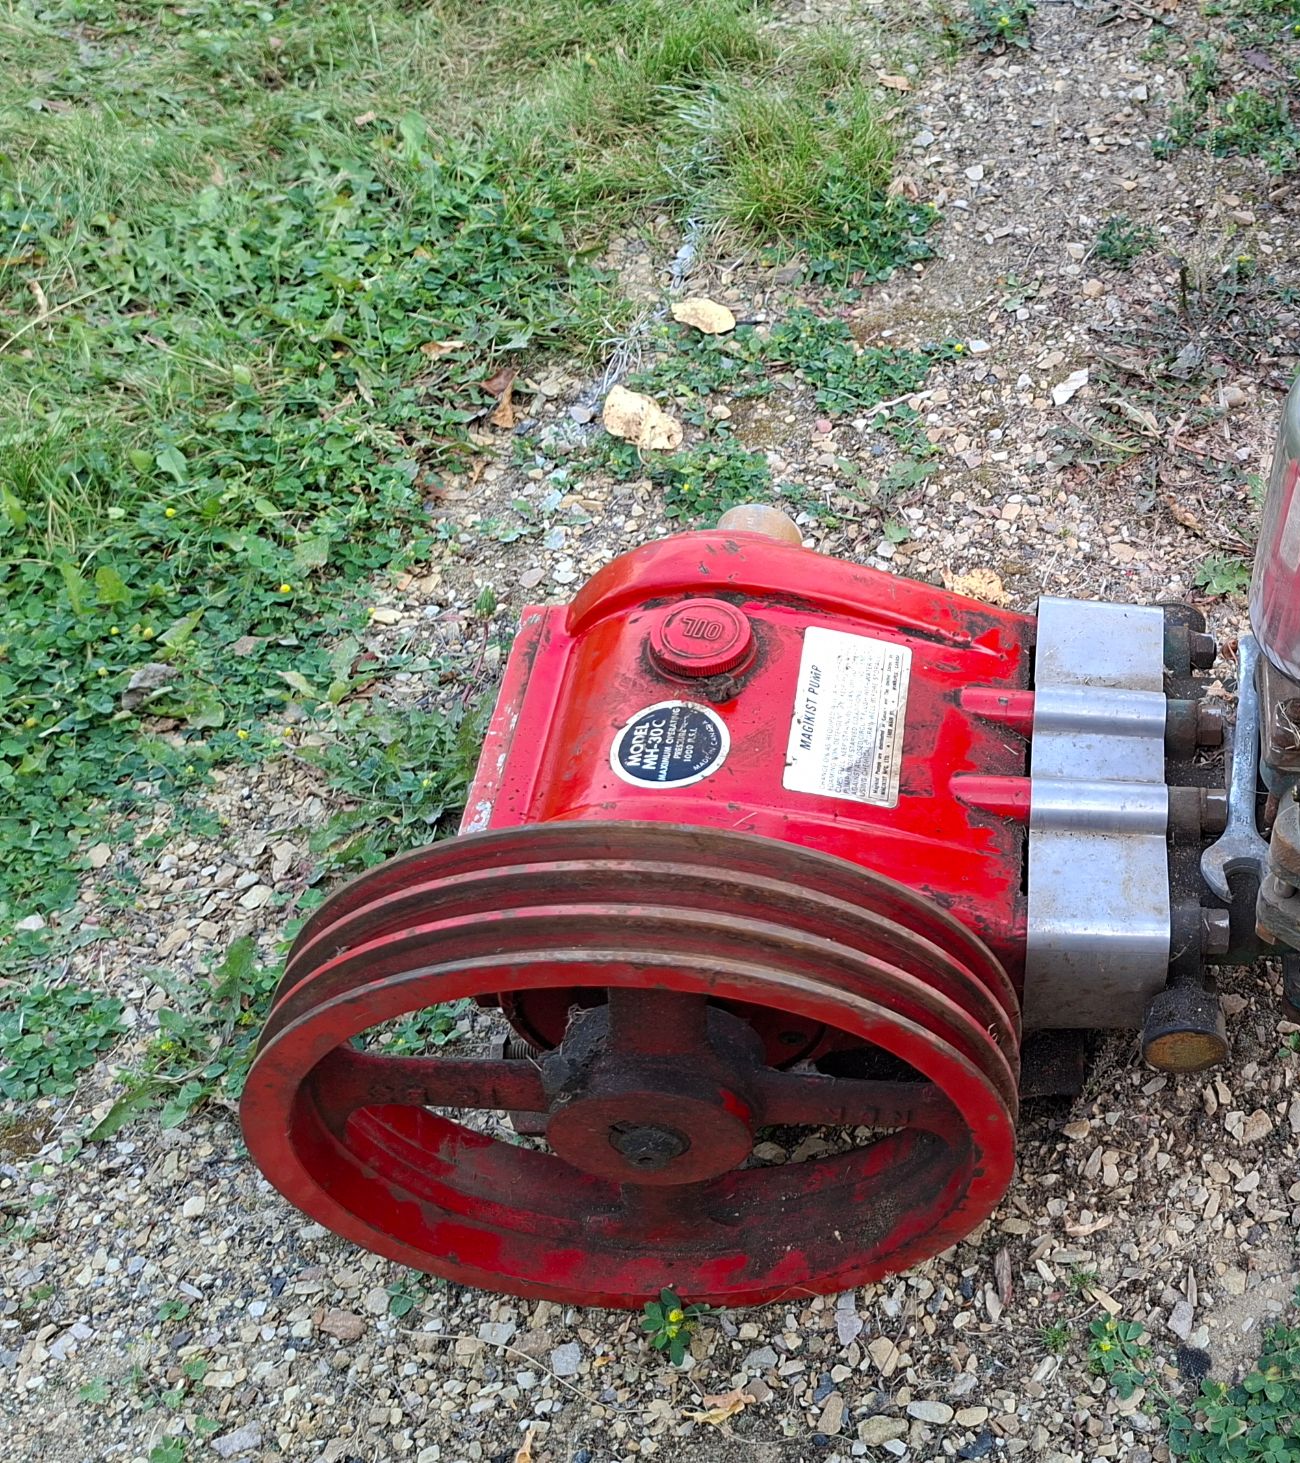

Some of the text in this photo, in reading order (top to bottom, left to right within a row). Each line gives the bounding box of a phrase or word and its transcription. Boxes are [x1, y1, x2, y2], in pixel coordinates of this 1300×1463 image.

[682, 617, 722, 640] OIL
[800, 664, 822, 750] MAGIKIST PUMP
[626, 723, 649, 765] MODEL
[642, 718, 666, 769] MH-30C
[657, 707, 680, 780] MAXIMUM OPERATING
[683, 744, 693, 762] 1000
[692, 753, 711, 770] MADE
